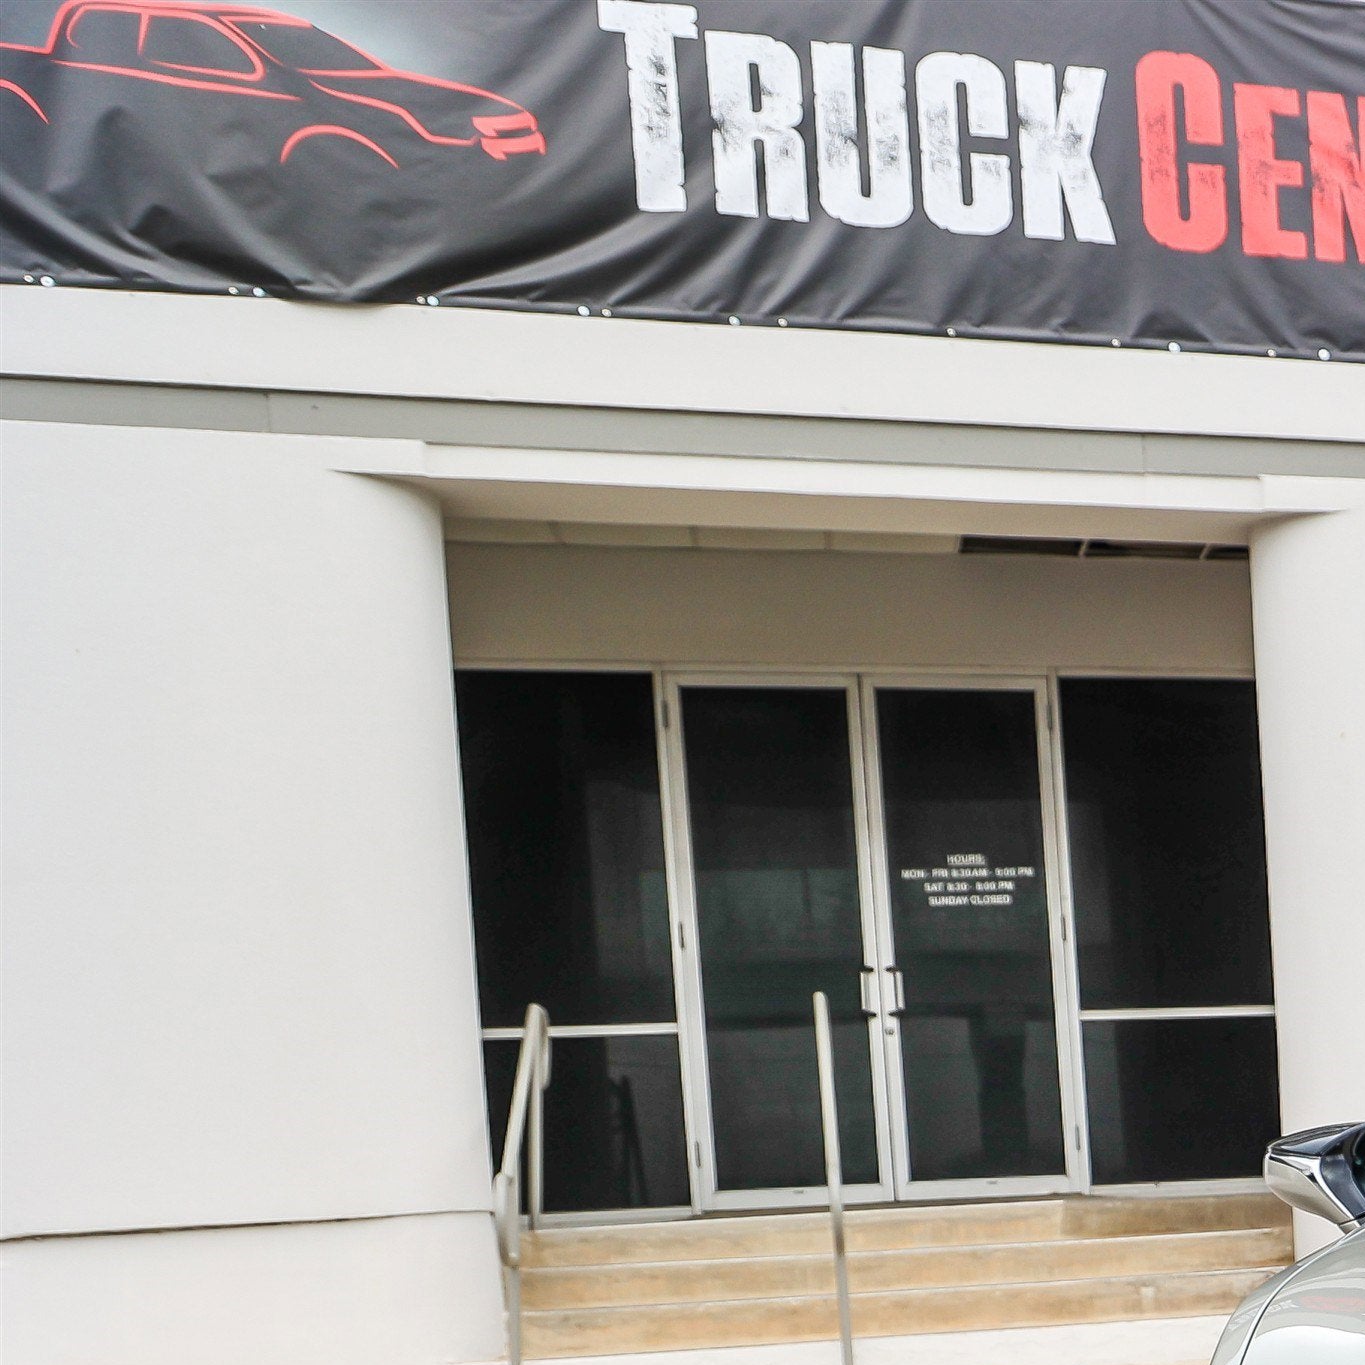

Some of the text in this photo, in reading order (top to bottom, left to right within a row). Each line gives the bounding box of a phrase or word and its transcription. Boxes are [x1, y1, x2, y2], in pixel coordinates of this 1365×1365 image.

[598, 0, 1118, 245] TRUCK
[928, 894, 1013, 907] SUNDAY CLOSED
